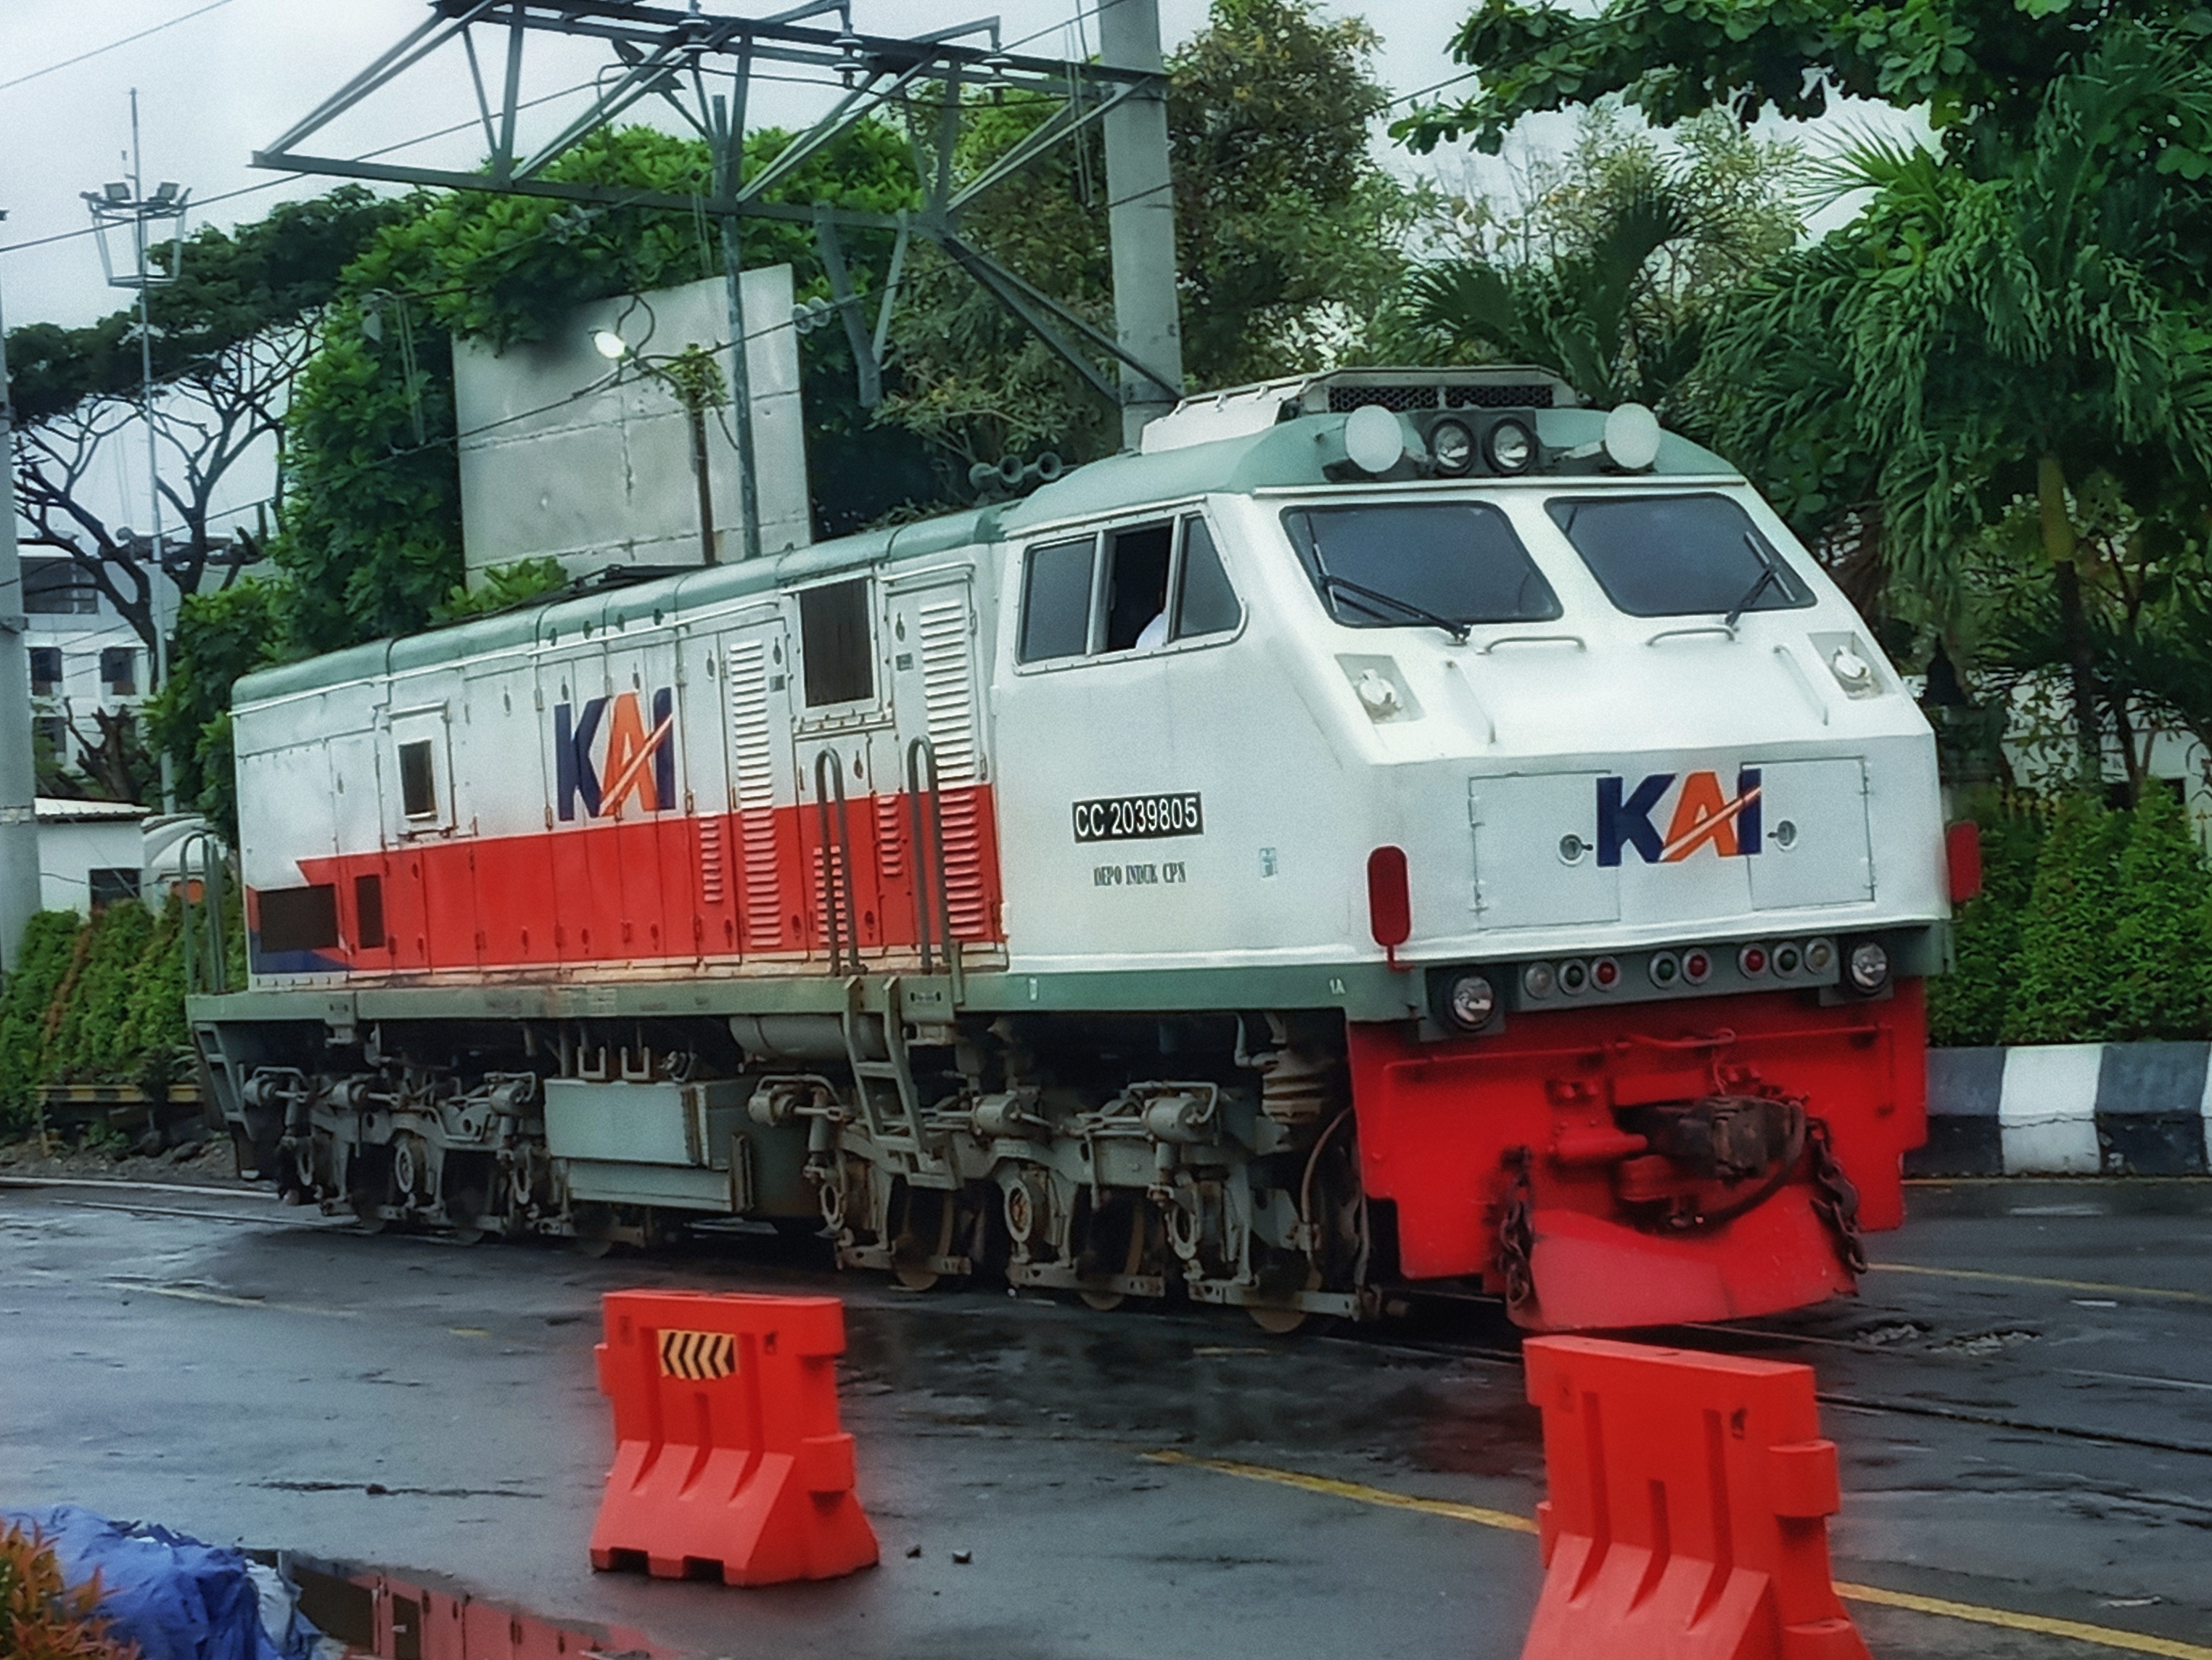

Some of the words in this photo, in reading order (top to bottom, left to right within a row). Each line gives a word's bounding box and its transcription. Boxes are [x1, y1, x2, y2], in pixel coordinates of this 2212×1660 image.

[554, 686, 675, 821] KAI
[1076, 804, 1104, 837] CC
[1110, 797, 1197, 834] 2039805
[1596, 768, 1761, 867] KAI
[1093, 865, 1122, 886] DEPO
